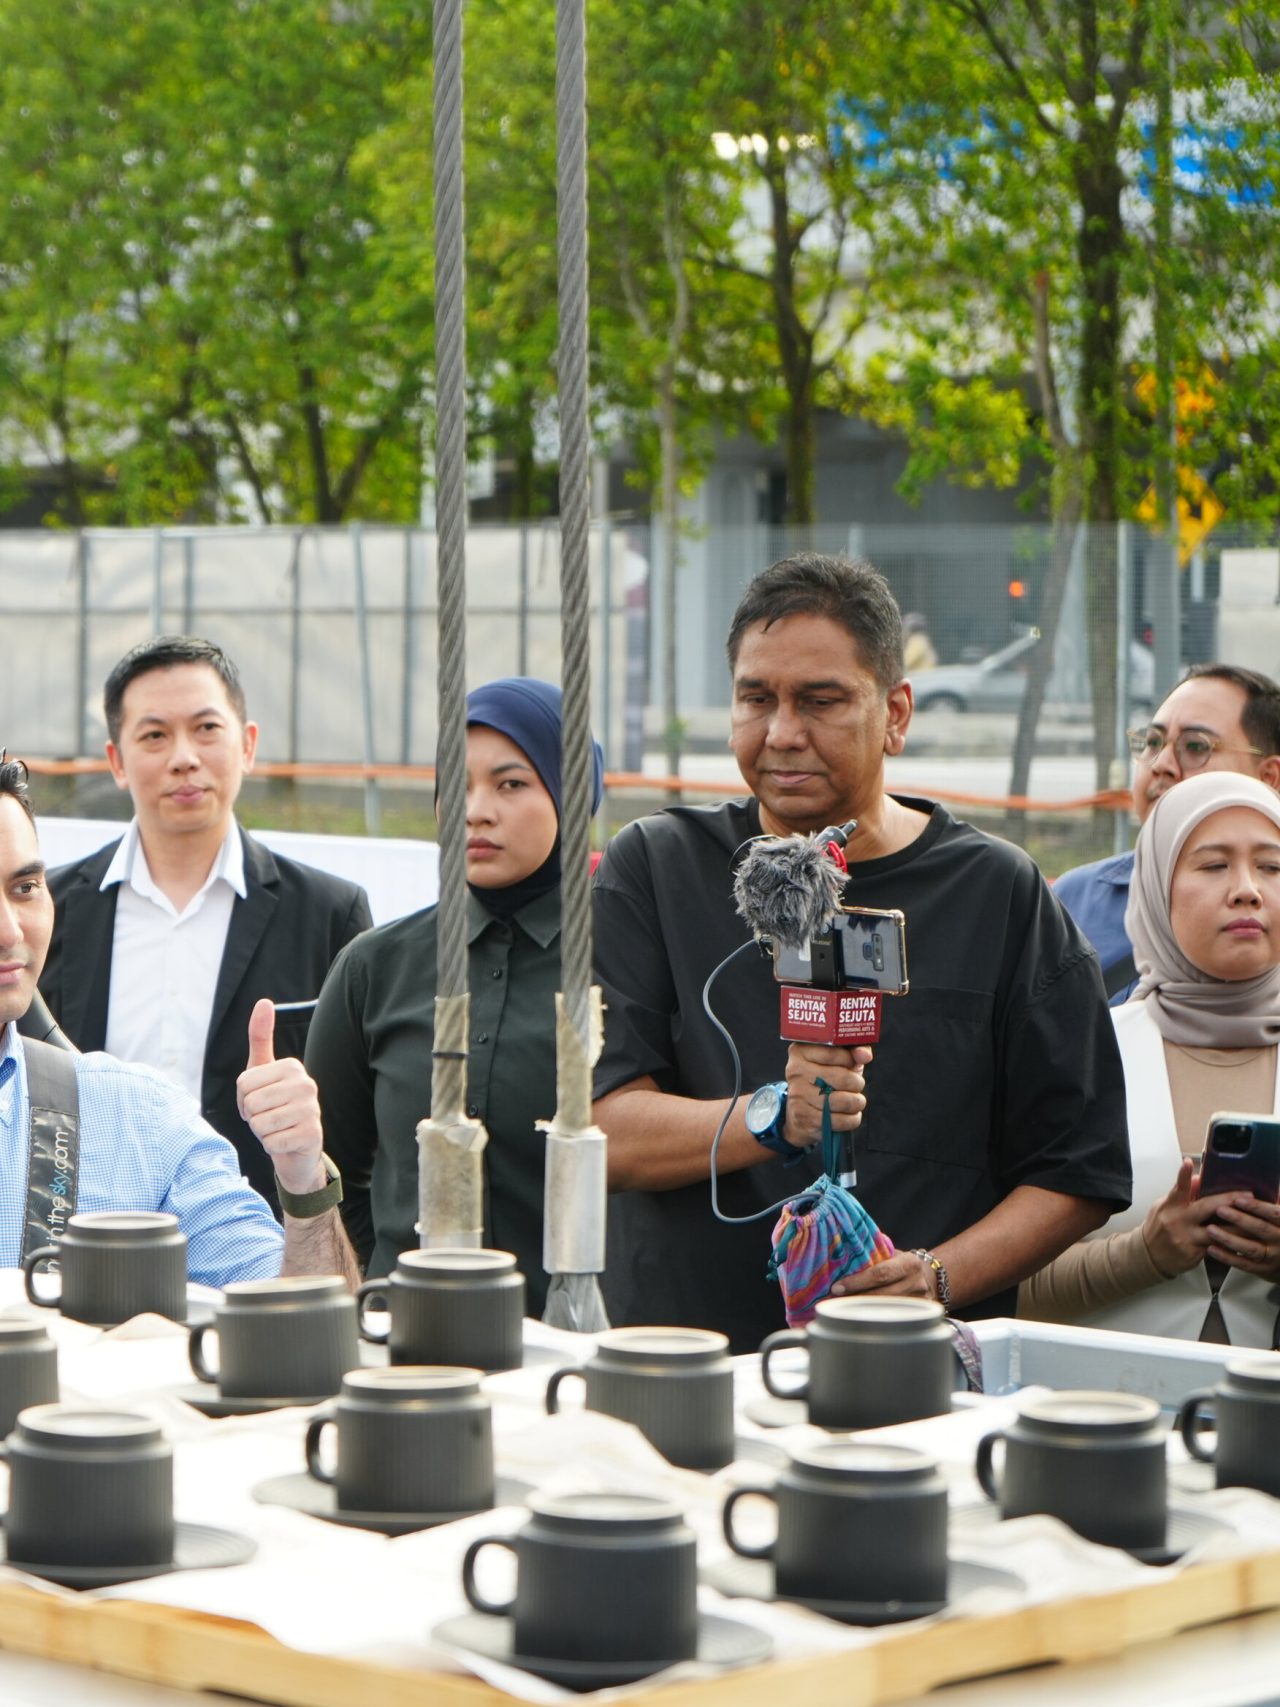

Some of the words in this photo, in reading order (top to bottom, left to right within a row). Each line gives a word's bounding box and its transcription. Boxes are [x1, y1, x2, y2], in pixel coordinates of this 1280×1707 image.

[788, 998, 826, 1012] RENTAK
[840, 996, 876, 1009] RENTAK
[788, 1010, 826, 1023] SEJUTA
[839, 1009, 875, 1022] SEJUTA
[49, 1131, 70, 1195] sky.com
[47, 1197, 66, 1225] the
